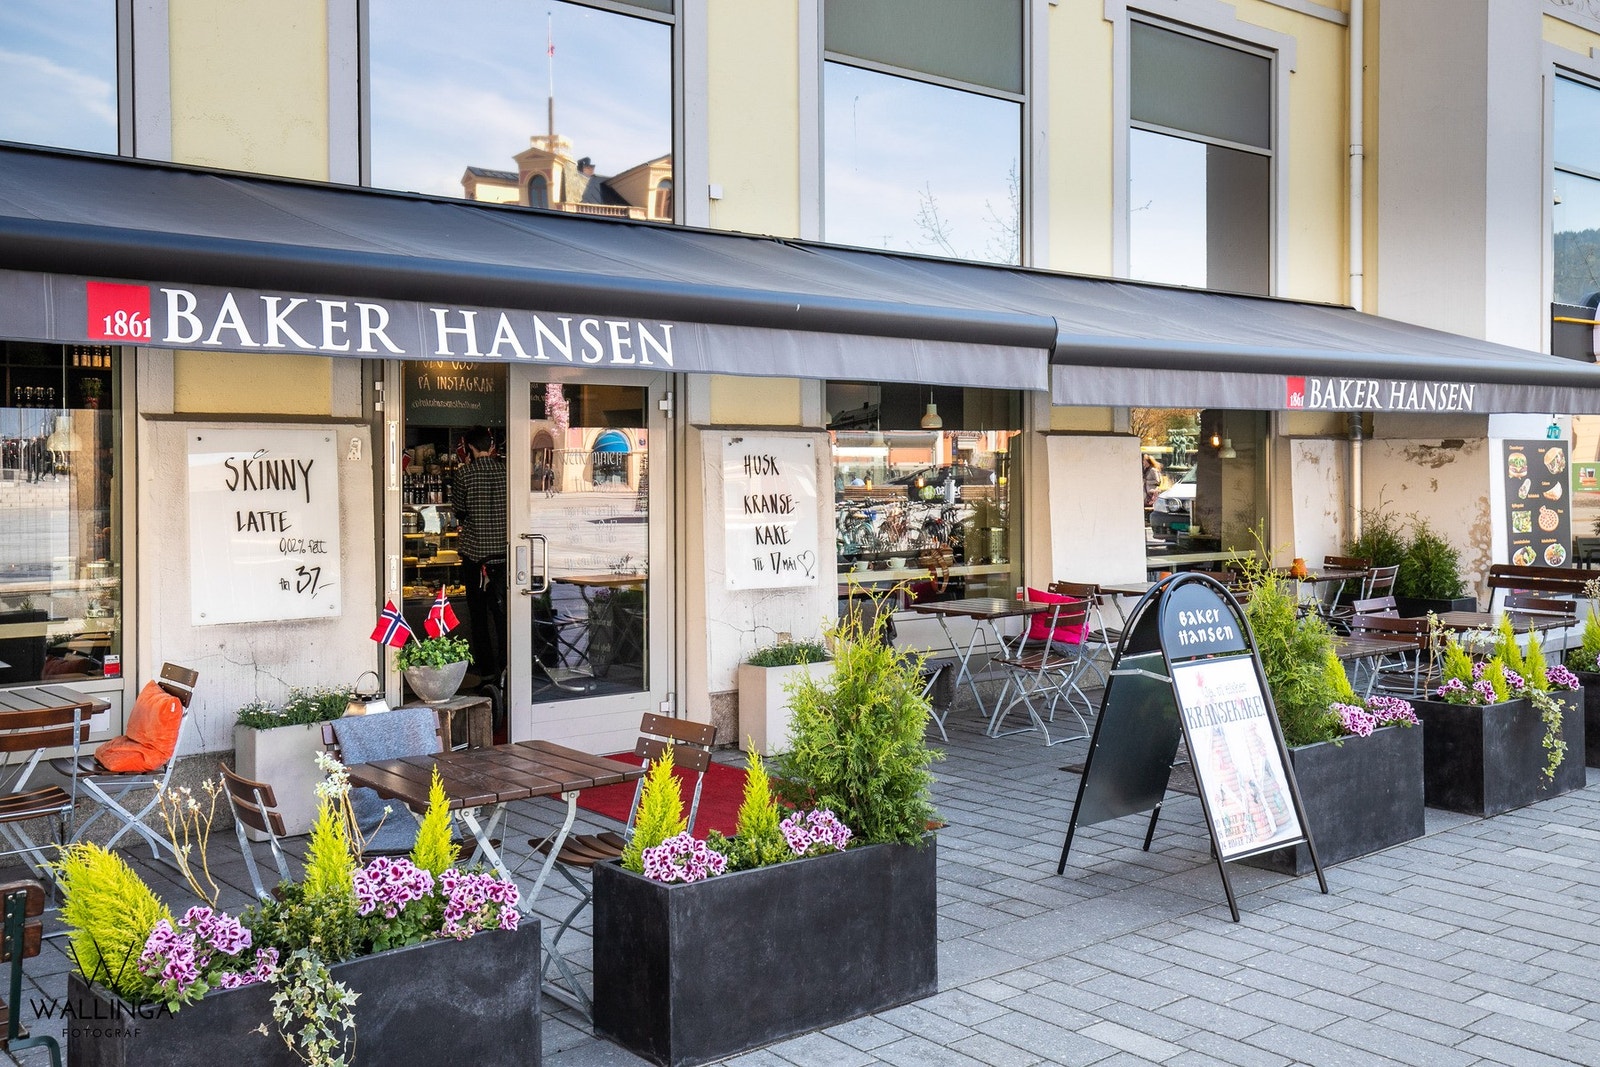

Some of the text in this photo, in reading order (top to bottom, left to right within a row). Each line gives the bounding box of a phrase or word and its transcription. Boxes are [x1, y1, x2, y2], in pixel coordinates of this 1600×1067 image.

[103, 311, 151, 338] 1861
[160, 288, 674, 367] BAKER HANSEN
[1290, 392, 1304, 407] 1861
[1309, 378, 1475, 411] BAKER HANSEN
[224, 449, 314, 504] SKINNY
[744, 454, 780, 479] HUSK
[744, 493, 800, 515] KRANSE-
[236, 510, 292, 533] LATTE
[755, 525, 791, 546] KAKE
[1185, 695, 1266, 730] KRANSEKAKE!
